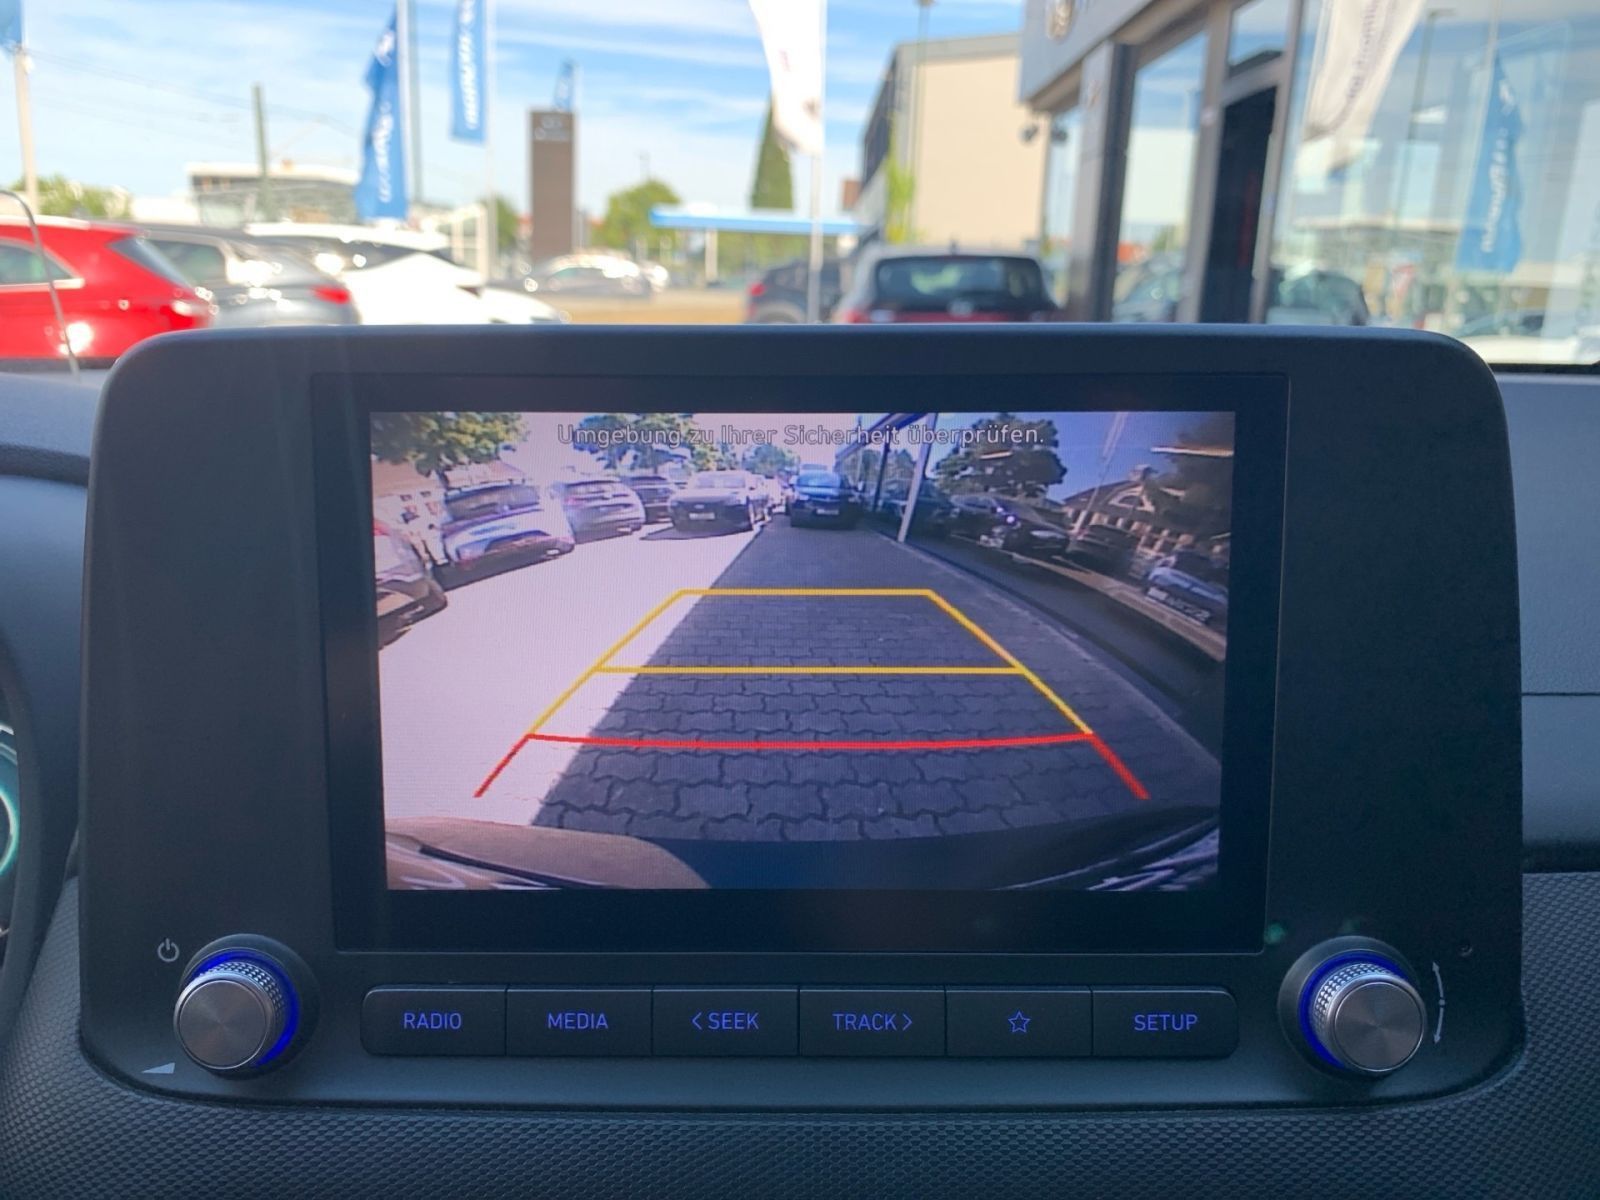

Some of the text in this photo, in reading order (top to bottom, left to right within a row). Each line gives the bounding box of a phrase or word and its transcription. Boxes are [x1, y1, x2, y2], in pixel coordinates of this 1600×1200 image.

[557, 423, 1045, 449] Umgebung zu Ihrer Sicherheit überprüfen.
[403, 1012, 462, 1031] RADIO
[547, 1012, 609, 1031] MEDIA
[707, 1012, 760, 1031] SEEK
[832, 1013, 898, 1032] TRACK
[1133, 1013, 1199, 1032] SETUP
